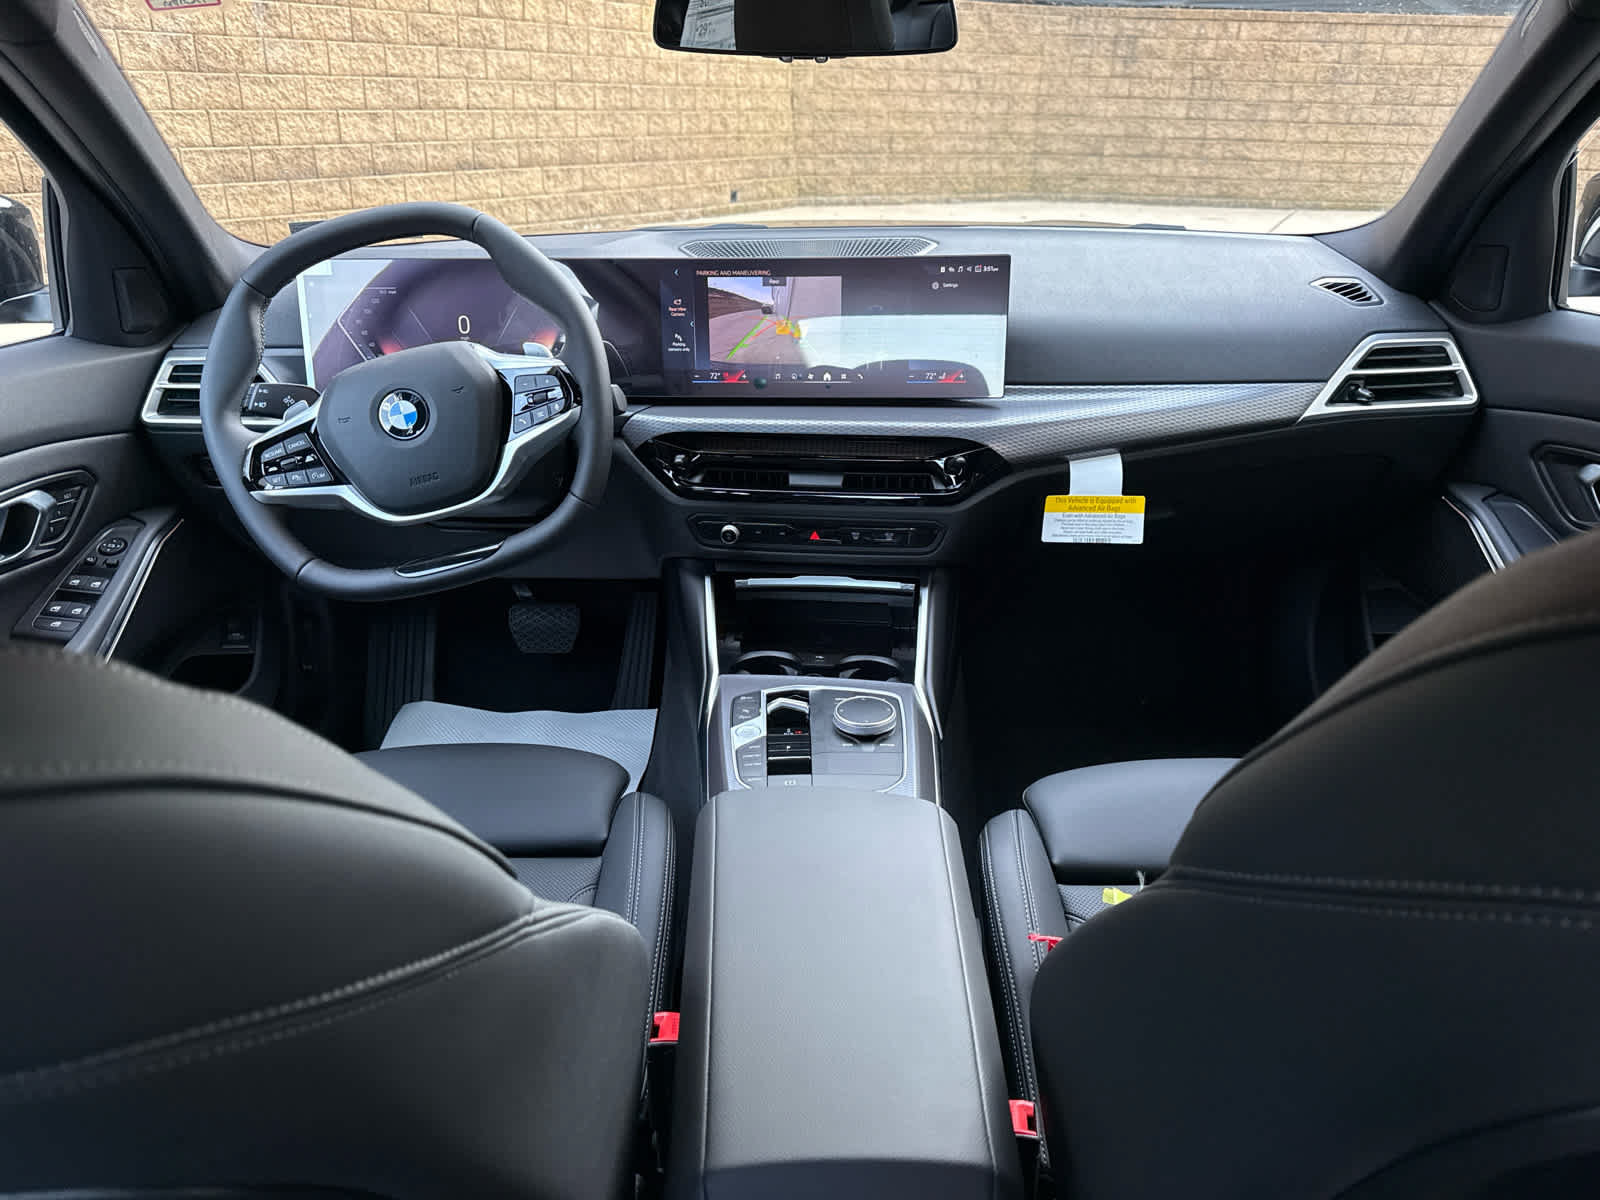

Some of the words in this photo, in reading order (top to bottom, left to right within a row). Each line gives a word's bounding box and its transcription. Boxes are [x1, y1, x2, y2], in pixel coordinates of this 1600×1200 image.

[458, 315, 470, 334] 0
[1068, 496, 1088, 504] Vehicle
[1095, 497, 1124, 505] Equipped
